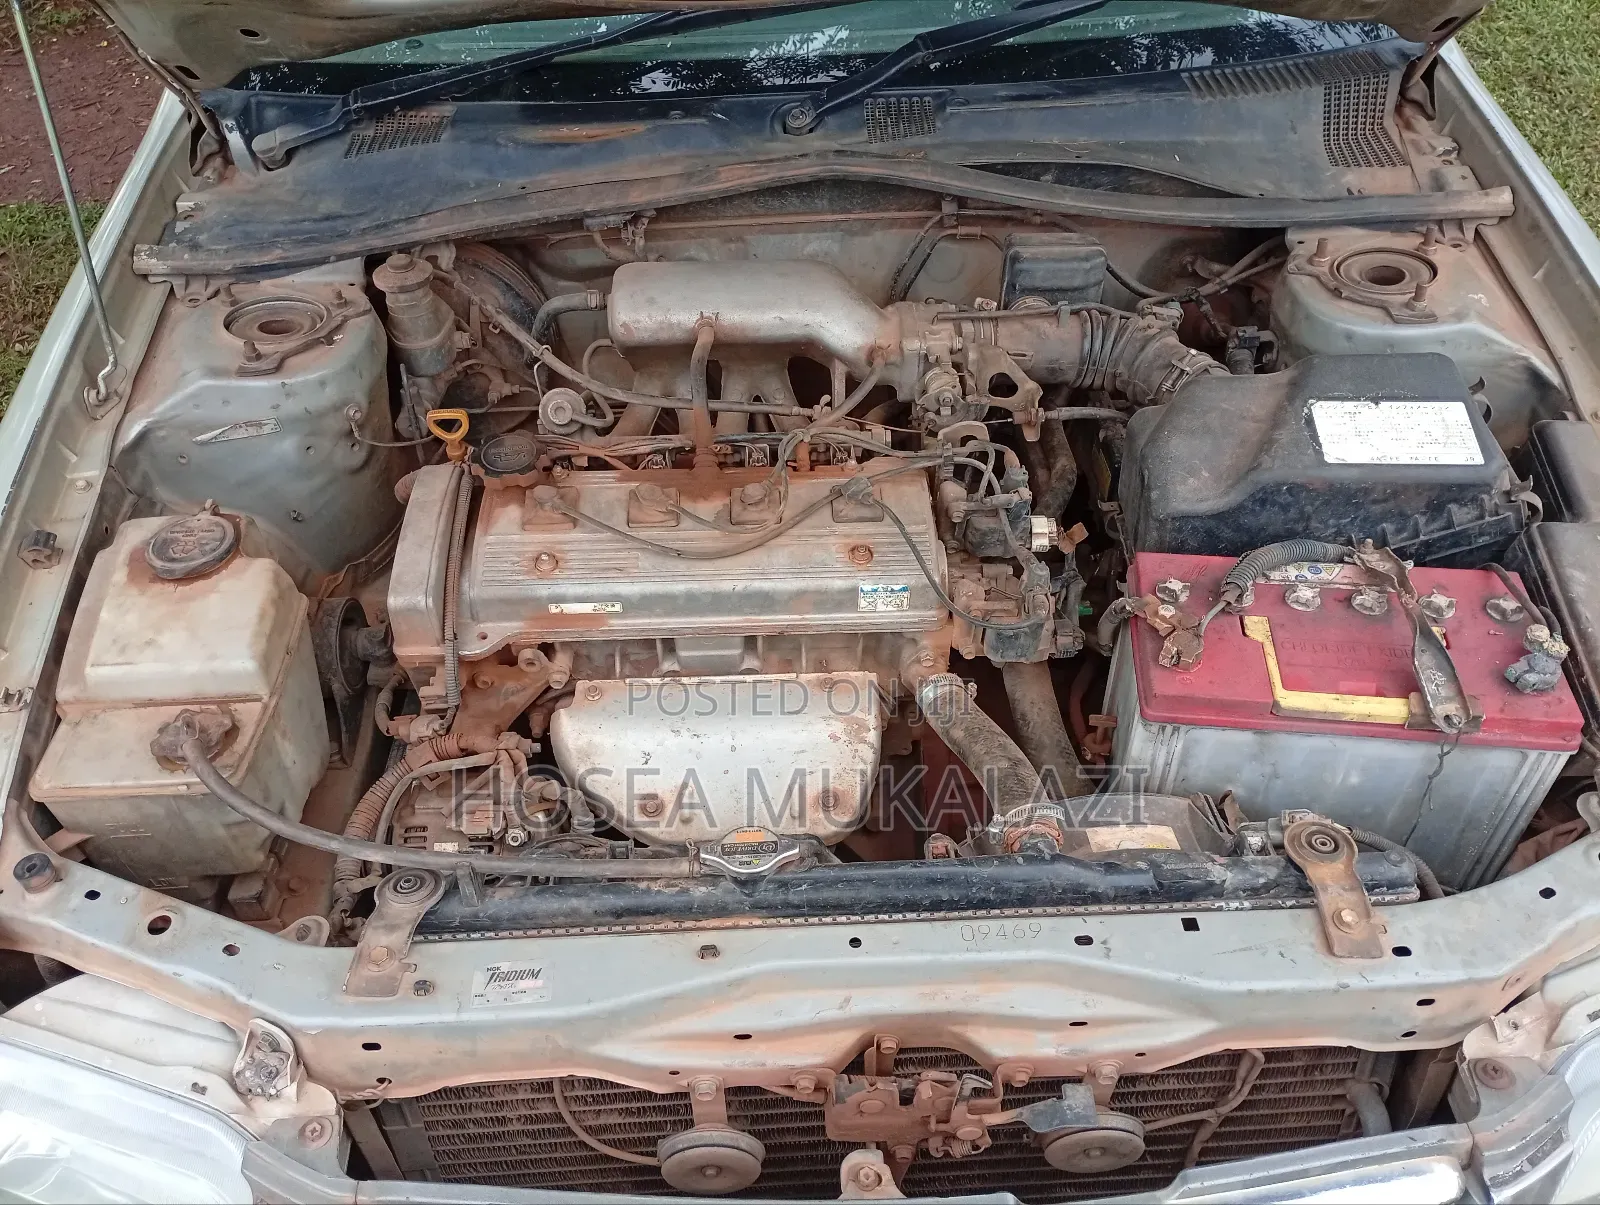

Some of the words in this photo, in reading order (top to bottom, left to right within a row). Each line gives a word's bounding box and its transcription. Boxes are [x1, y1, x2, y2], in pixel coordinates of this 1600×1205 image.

[961, 922, 1042, 942] 09469
[484, 967, 543, 990] IRIDIUM
[486, 965, 502, 973] NGK
